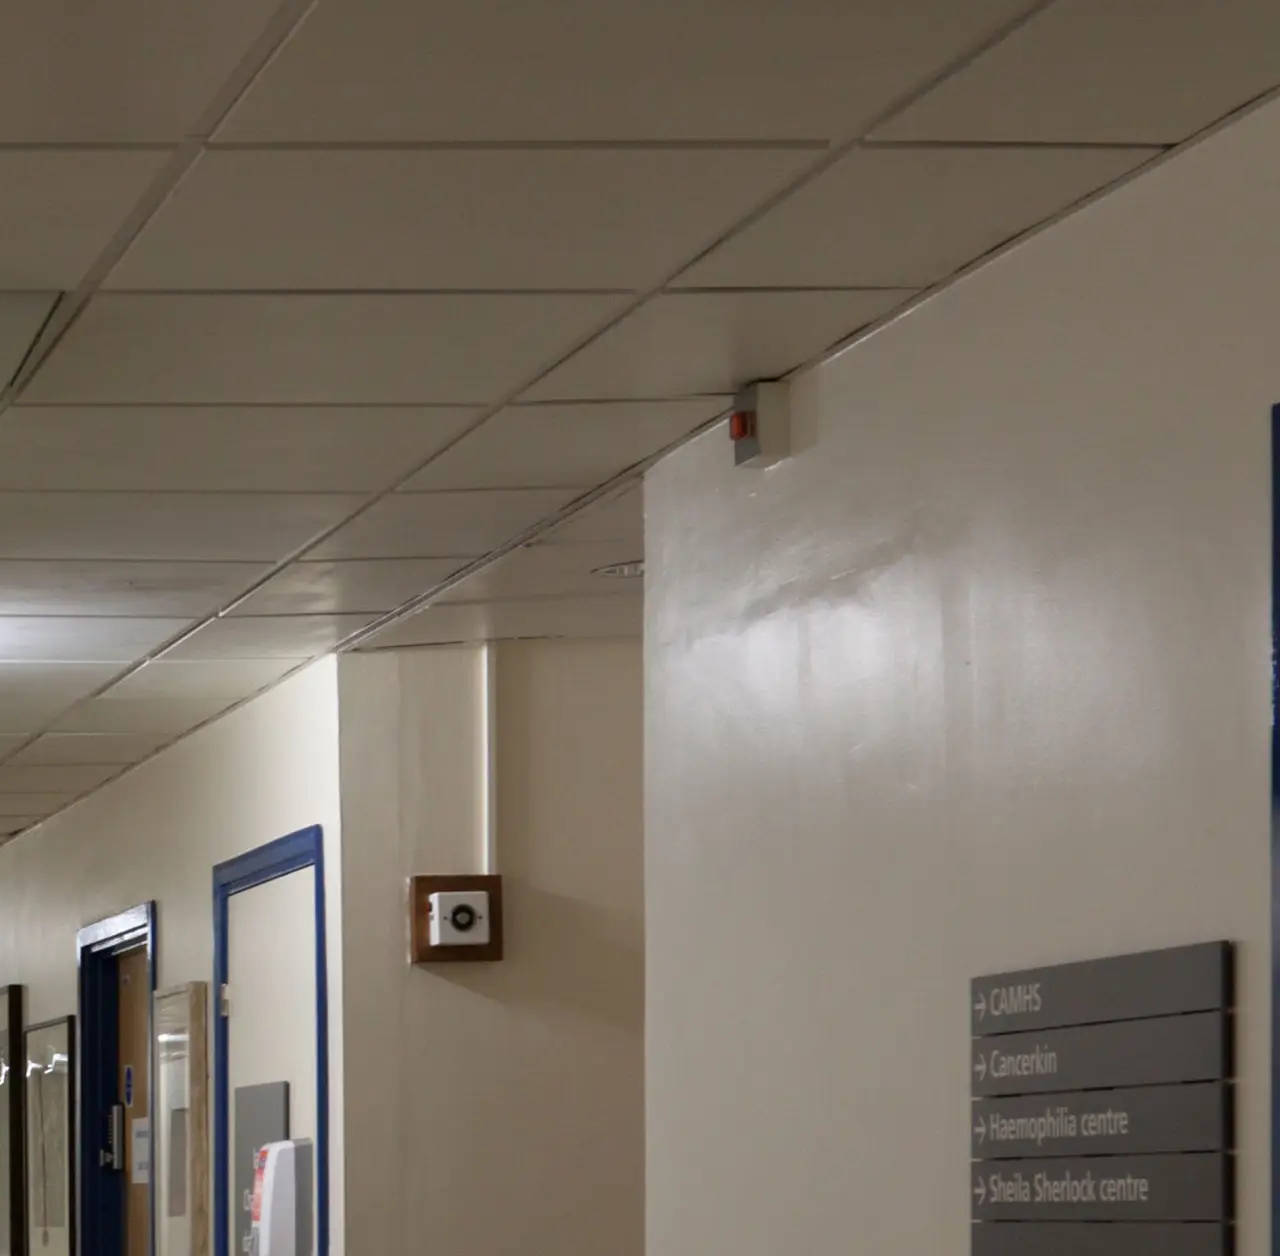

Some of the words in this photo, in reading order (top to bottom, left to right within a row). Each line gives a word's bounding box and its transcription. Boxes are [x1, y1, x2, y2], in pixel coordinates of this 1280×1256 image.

[989, 982, 1042, 1016] CAMHS
[989, 1044, 1058, 1079] Cancerkin
[989, 1106, 1077, 1146] Haemophilia
[1080, 1109, 1130, 1138] centre
[989, 1173, 1031, 1203] Sheila
[1033, 1171, 1097, 1203] Sherlock
[1099, 1174, 1149, 1202] centre
